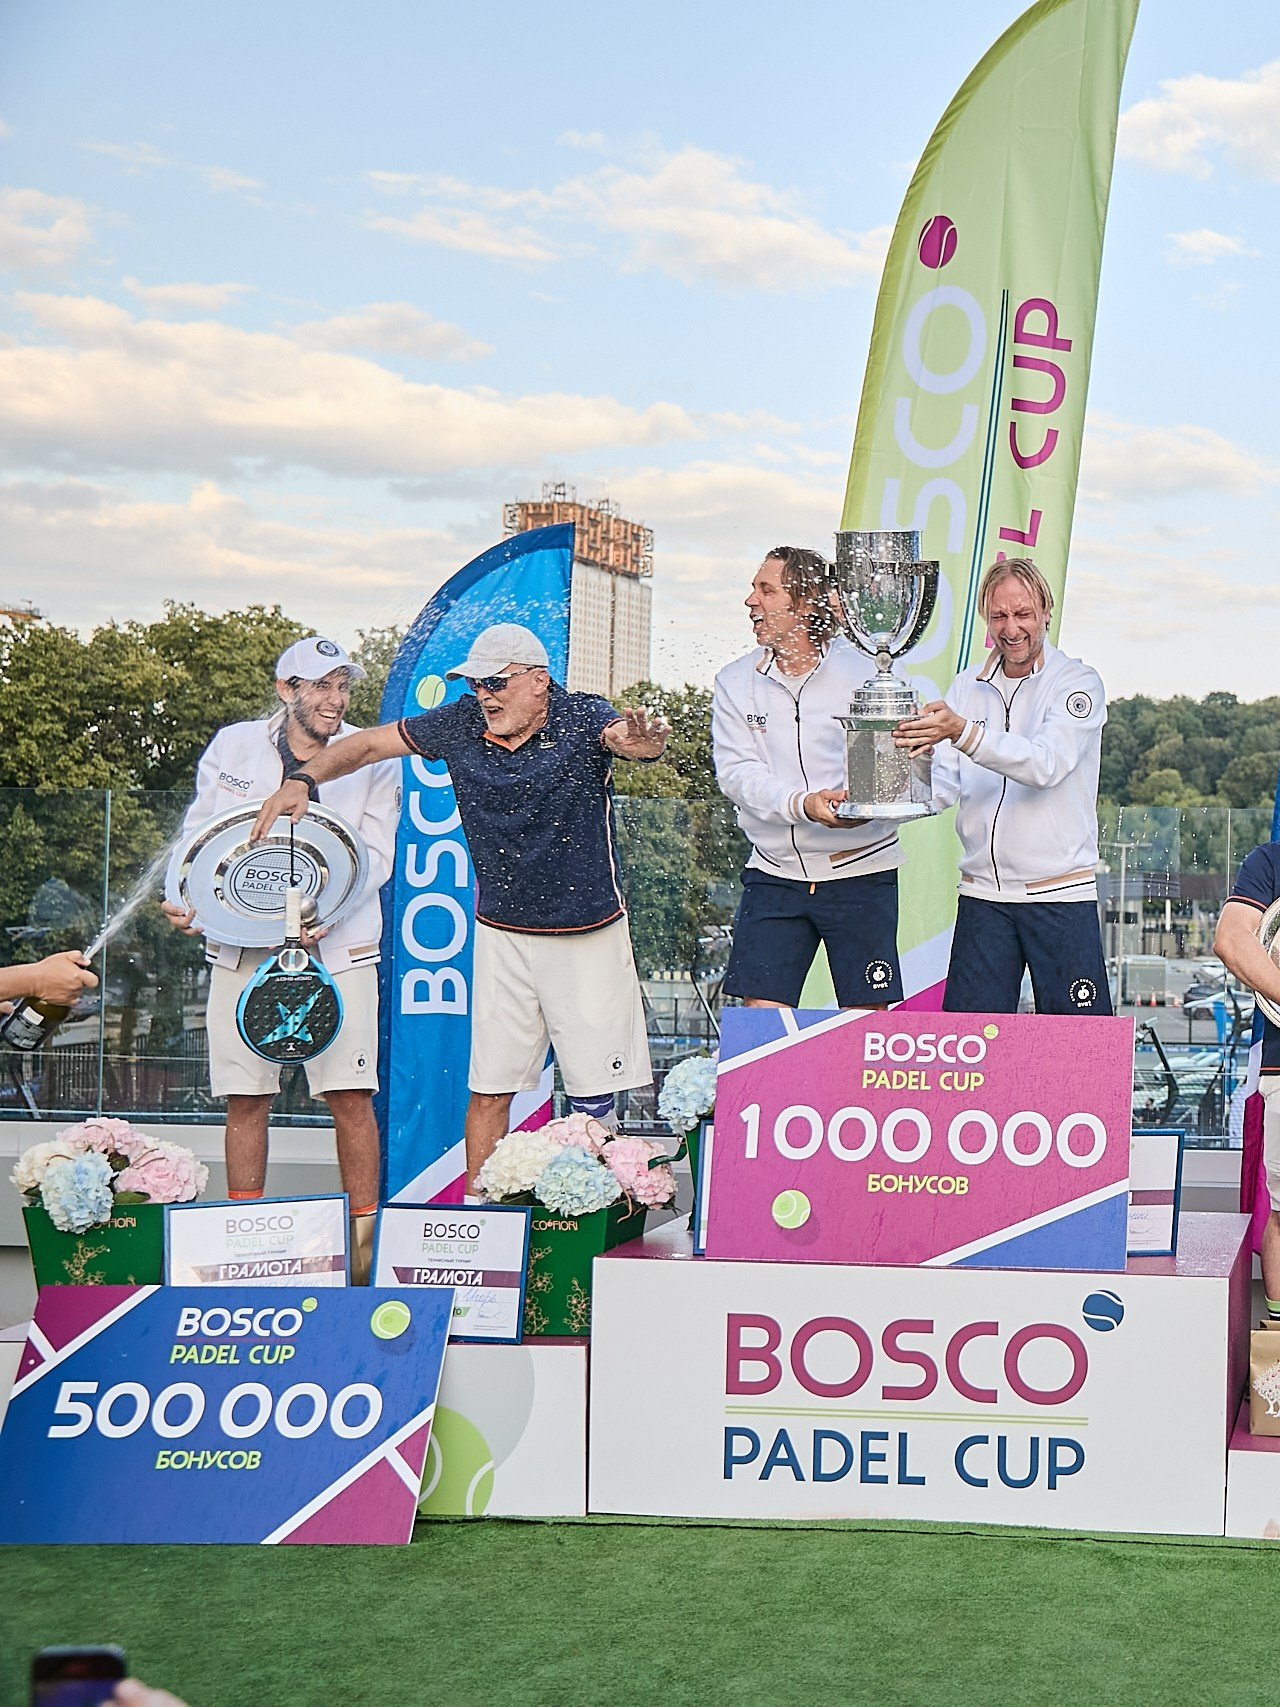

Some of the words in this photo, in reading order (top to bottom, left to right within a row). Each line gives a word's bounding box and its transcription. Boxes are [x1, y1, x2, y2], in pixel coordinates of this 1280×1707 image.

[1009, 297, 1073, 470] CUP
[219, 772, 250, 790] BOSCO
[245, 868, 303, 883] BOSCO
[242, 881, 273, 892] PADEL
[863, 1032, 987, 1064] BOSCO
[862, 1069, 932, 1090] PADEL
[939, 1071, 985, 1091] CUP
[947, 1109, 1107, 1168] 000
[867, 1173, 969, 1195] БОНУСОВ
[225, 1215, 294, 1234] BOSCO
[423, 1223, 480, 1239] BOSCO
[552, 1220, 578, 1231] FIORI
[226, 1237, 264, 1249] PADEL
[269, 1234, 294, 1245] CUP
[422, 1243, 454, 1255] PADEL
[457, 1244, 479, 1255] CUP
[218, 1259, 302, 1281] ГРАМОТА
[413, 1268, 484, 1286] ГРАМОТА
[176, 1307, 303, 1337] BOSCO
[169, 1345, 240, 1364] PADEL
[249, 1345, 296, 1364] CUP
[725, 1313, 1088, 1405] BOSCO
[47, 1381, 206, 1439] 500
[219, 1382, 383, 1439] 000
[155, 1450, 262, 1470] БОНУСОВ
[723, 1426, 926, 1486] PADEL
[954, 1435, 1086, 1490] CUP
